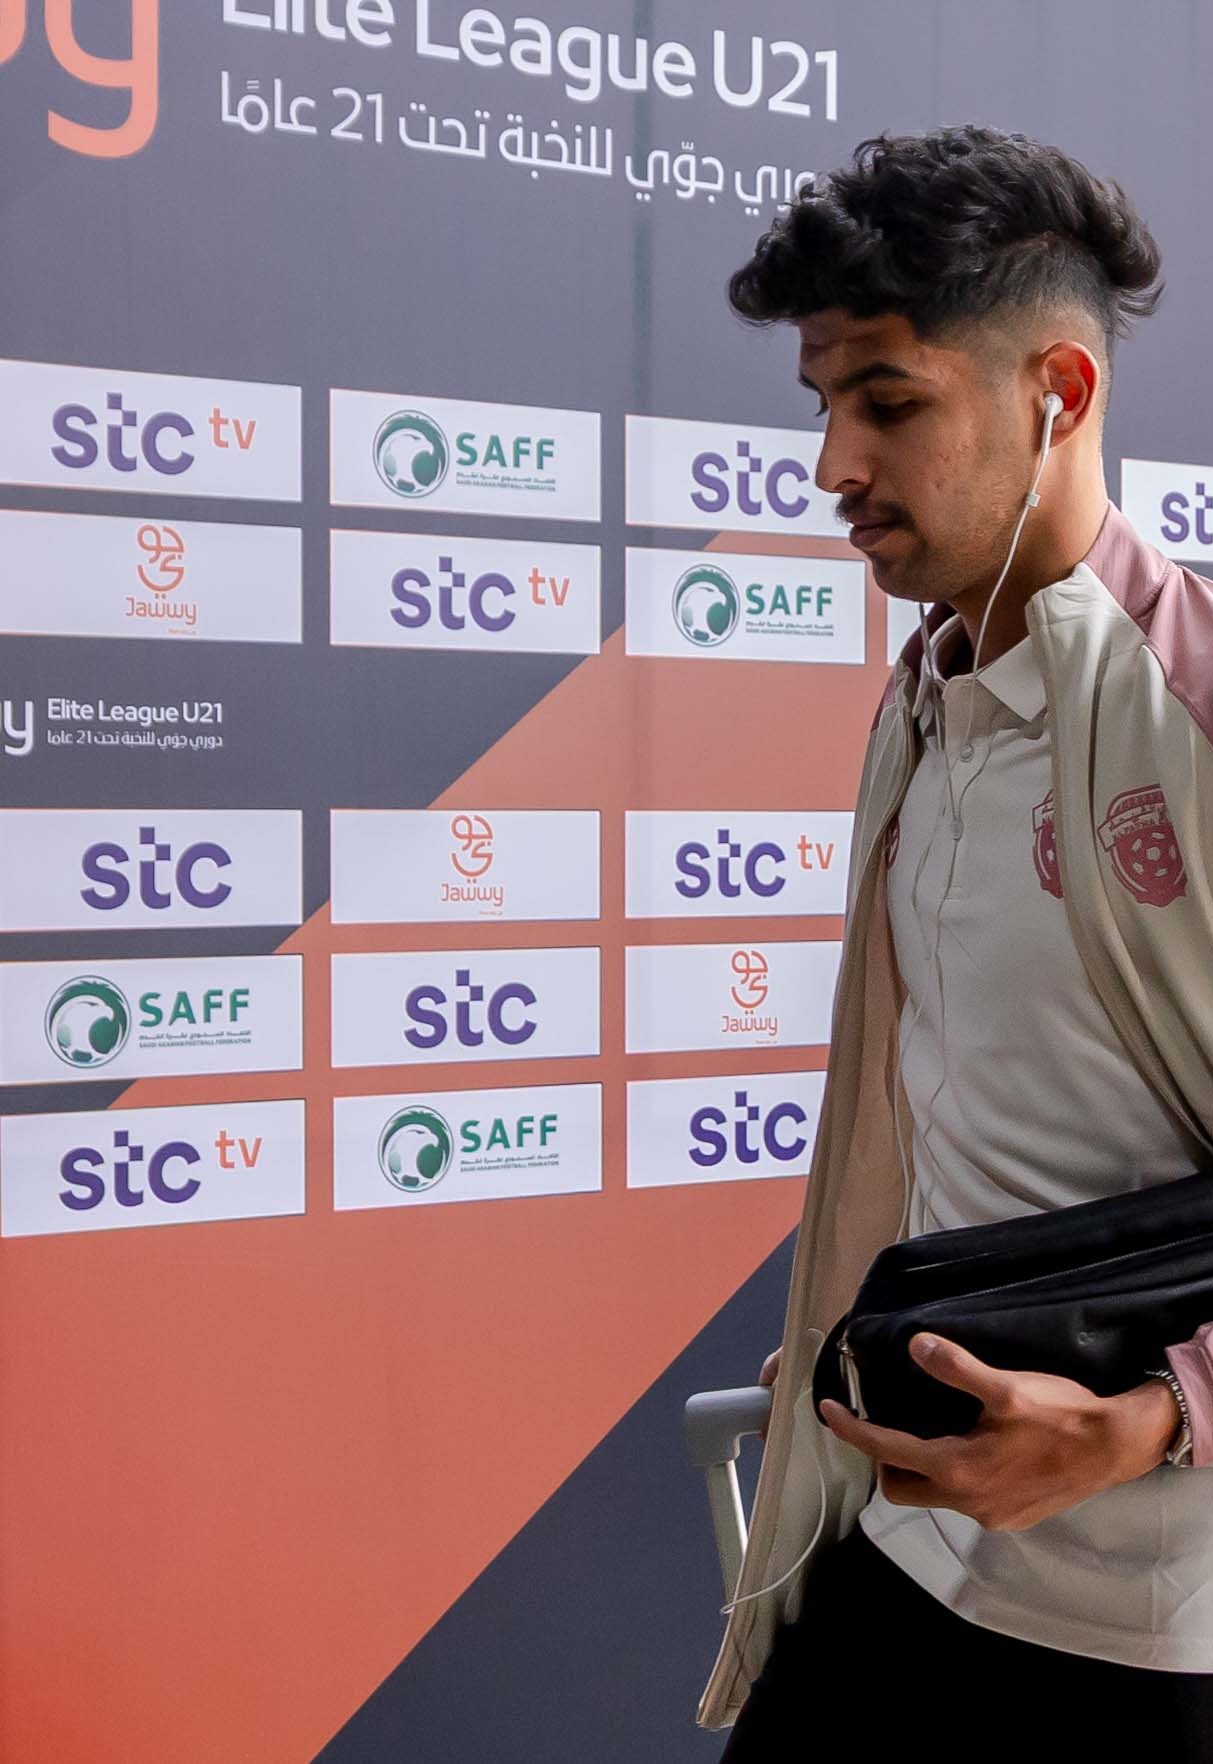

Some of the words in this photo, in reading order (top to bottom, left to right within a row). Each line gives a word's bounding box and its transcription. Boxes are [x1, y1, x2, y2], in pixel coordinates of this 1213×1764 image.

[415, 0, 697, 102] League
[712, 29, 838, 121] U21
[330, 86, 383, 143] 21
[398, 101, 491, 158] تحت
[498, 113, 613, 179] للنخبة
[51, 393, 194, 475] stc
[209, 408, 255, 449] tv
[456, 433, 554, 470] SAFF
[691, 441, 809, 518] stc
[126, 597, 197, 625] Jawwy
[391, 557, 515, 632] stc
[528, 568, 569, 605] tv
[746, 584, 832, 616] SAFF
[47, 698, 94, 720] Elite
[98, 700, 179, 726] League
[182, 701, 223, 723] U21
[76, 730, 92, 744] 21
[94, 730, 120, 745] تحت
[121, 731, 155, 748] للنخبة
[189, 734, 223, 750] دوري
[80, 827, 232, 910] stc
[675, 829, 786, 898] stc
[797, 836, 833, 869] tv
[442, 882, 502, 906] Jawwy
[139, 989, 249, 1027] SAFF
[404, 969, 537, 1049] stc
[721, 1015, 778, 1036] Jawwy
[460, 1114, 557, 1153] SAFF
[689, 1091, 807, 1167] stc
[59, 1130, 201, 1211] stc
[215, 1131, 261, 1168] tv
